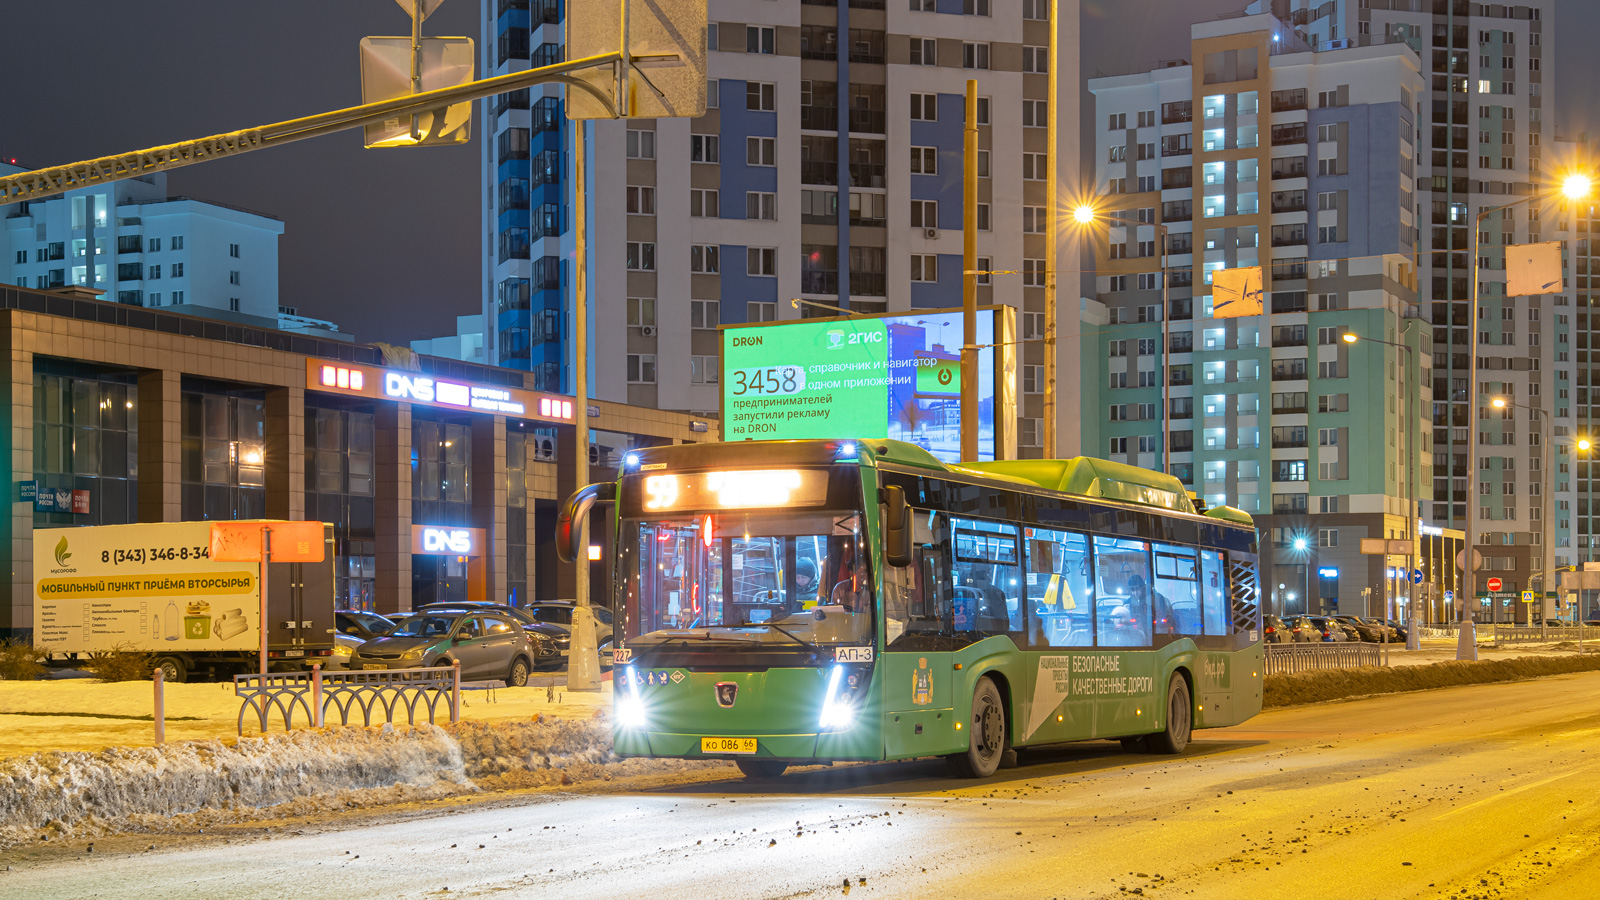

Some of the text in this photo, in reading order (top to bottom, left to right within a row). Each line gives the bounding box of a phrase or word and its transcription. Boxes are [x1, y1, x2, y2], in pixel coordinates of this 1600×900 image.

[733, 336, 763, 347] DRON
[848, 331, 883, 344] 2ГИС
[809, 361, 871, 374] справочник
[873, 361, 880, 369] и
[883, 357, 938, 369] навигатор
[386, 372, 434, 401] DNS
[733, 367, 797, 395] 3458
[800, 375, 911, 391] в одном приложении
[733, 394, 832, 410] предпринимателей
[733, 408, 831, 423] запустили рекламу
[748, 423, 777, 433] DRON
[424, 528, 471, 552] DNS
[101, 550, 110, 563] 8
[113, 548, 146, 565] (343)
[41, 577, 250, 593] МОБИЛЬНЫЙ ПУНКТ ПРИЁМА ВТОРСЫРЬЯ
[838, 648, 872, 661] АП-3
[1072, 655, 1120, 673] БЕЗОПАСНЫЕ
[1072, 676, 1153, 696] КАЧЕСТВЕННЫЕ ДОРОГИ
[721, 739, 739, 750] 086
[743, 739, 754, 748] 66
